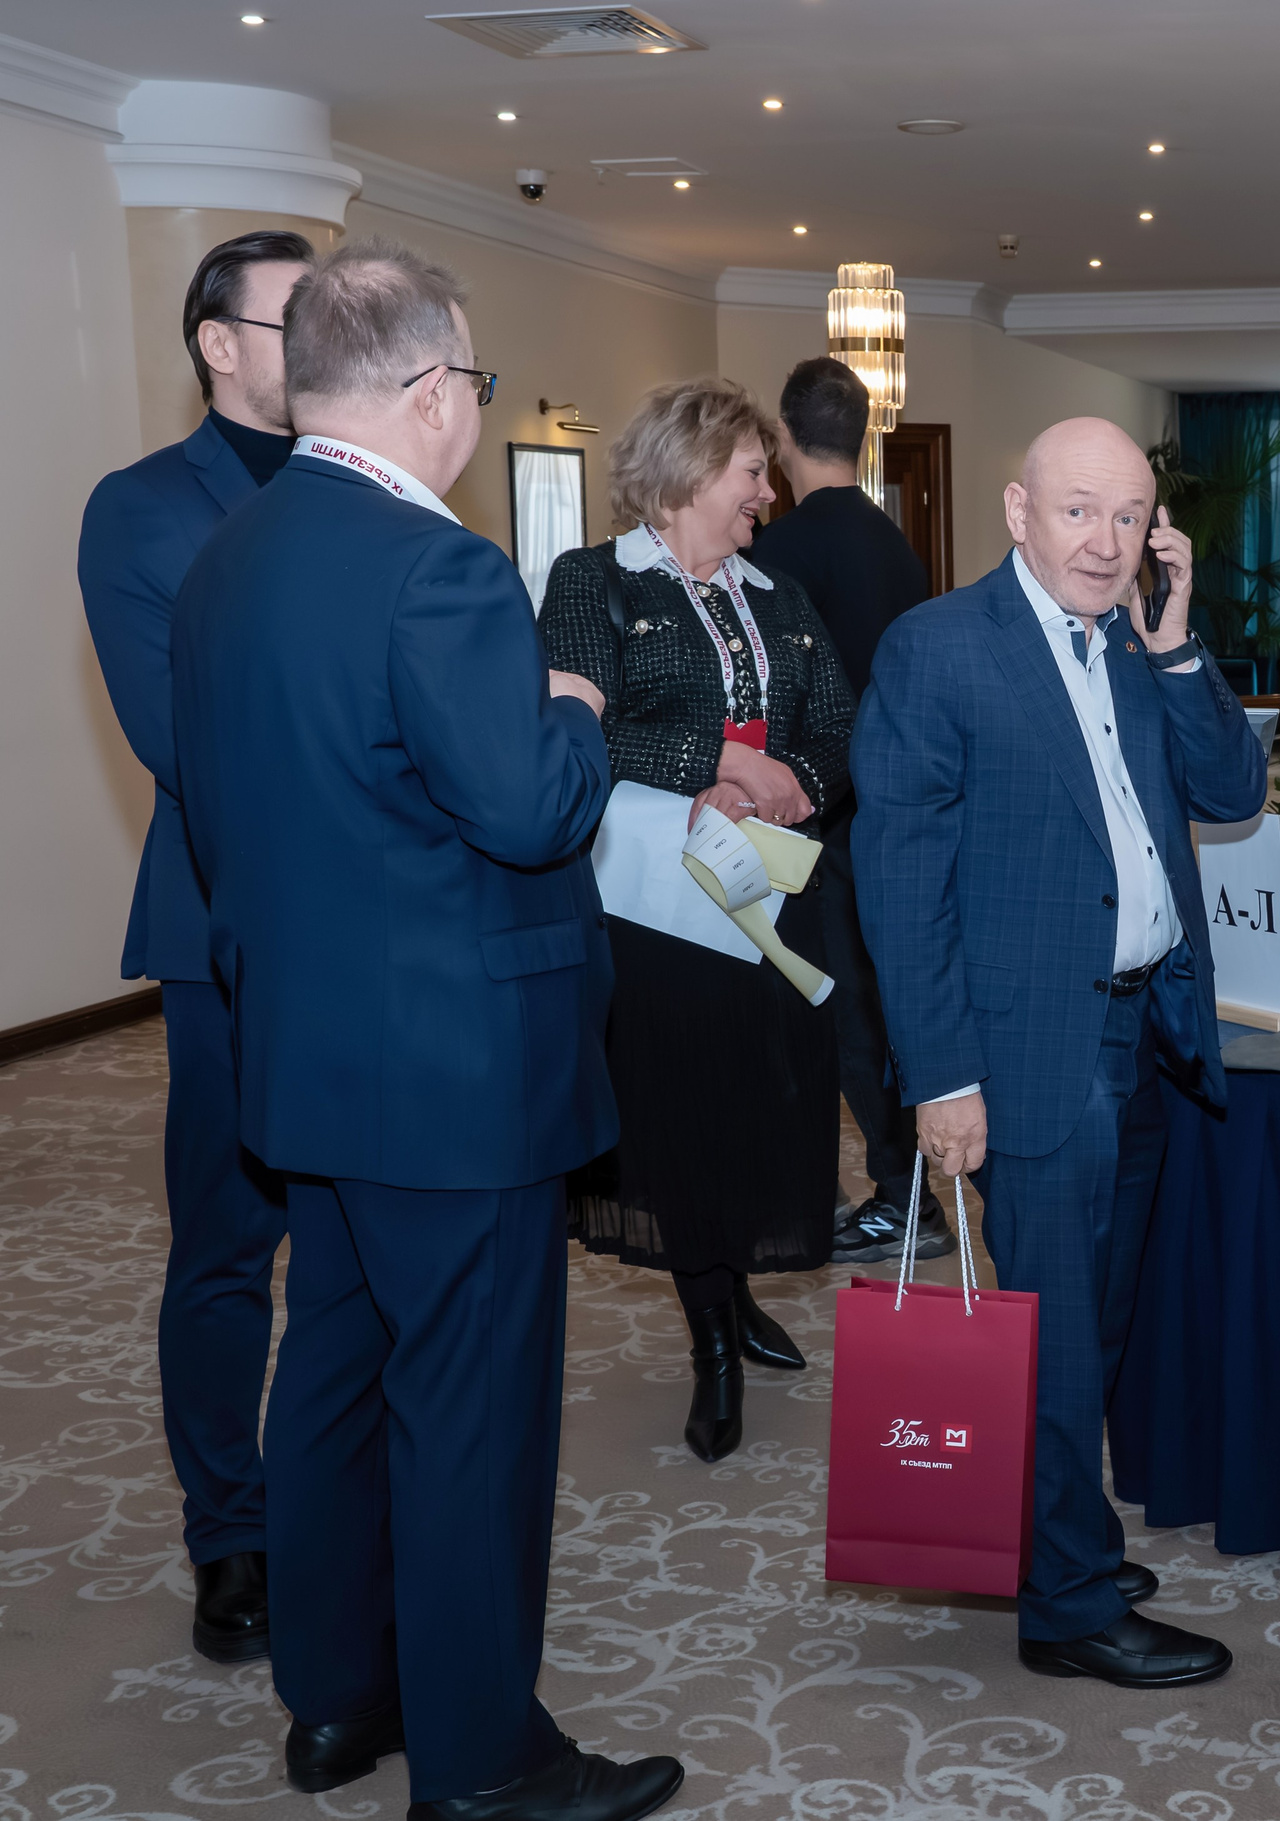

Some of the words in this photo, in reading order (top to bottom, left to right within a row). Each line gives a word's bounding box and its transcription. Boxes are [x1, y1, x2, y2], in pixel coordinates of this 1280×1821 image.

[311, 442, 347, 460] МТПП
[348, 452, 391, 484] СЪЕЗД
[732, 590, 745, 609] МТПП
[748, 627, 761, 651] СЪЕЗД
[757, 652, 766, 678] МТПП
[1213, 883, 1277, 934] А-Л
[908, 1460, 932, 1469] СЪЕЗД
[932, 1462, 952, 1470] МТПП
